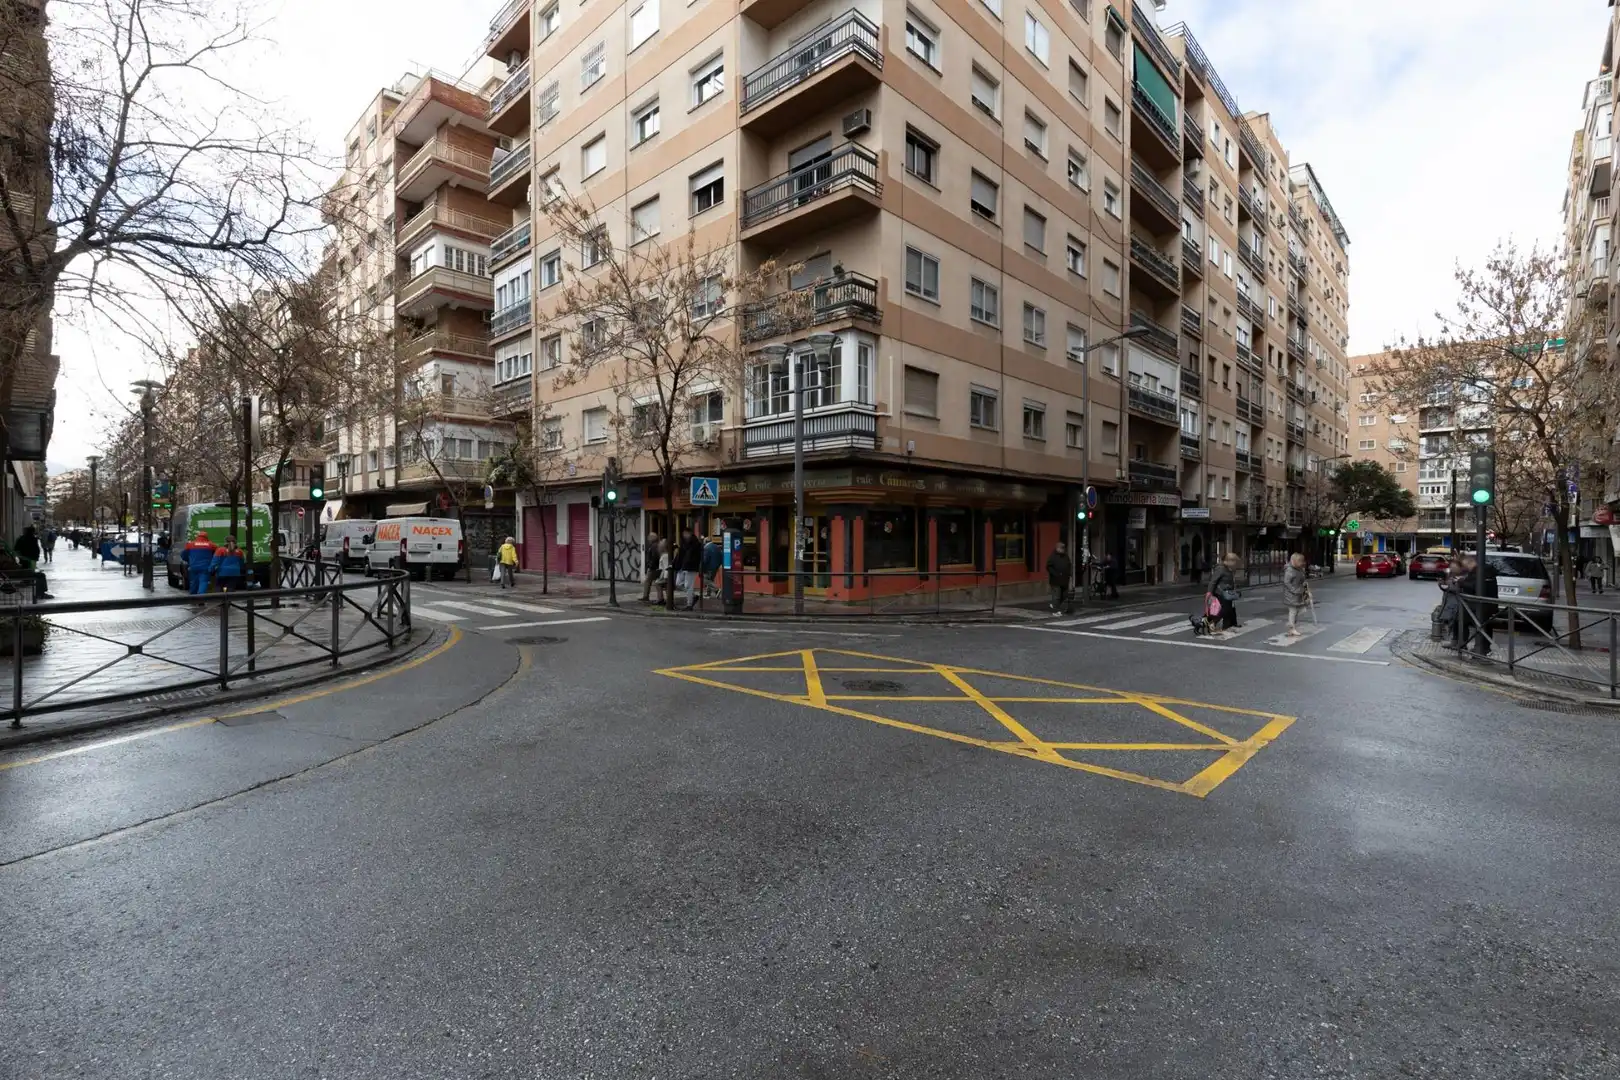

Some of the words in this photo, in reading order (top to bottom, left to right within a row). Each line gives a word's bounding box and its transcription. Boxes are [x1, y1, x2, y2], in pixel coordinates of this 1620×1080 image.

[377, 523, 401, 541] NACEX
[412, 525, 453, 537] NACEX
[733, 539, 742, 550] P
